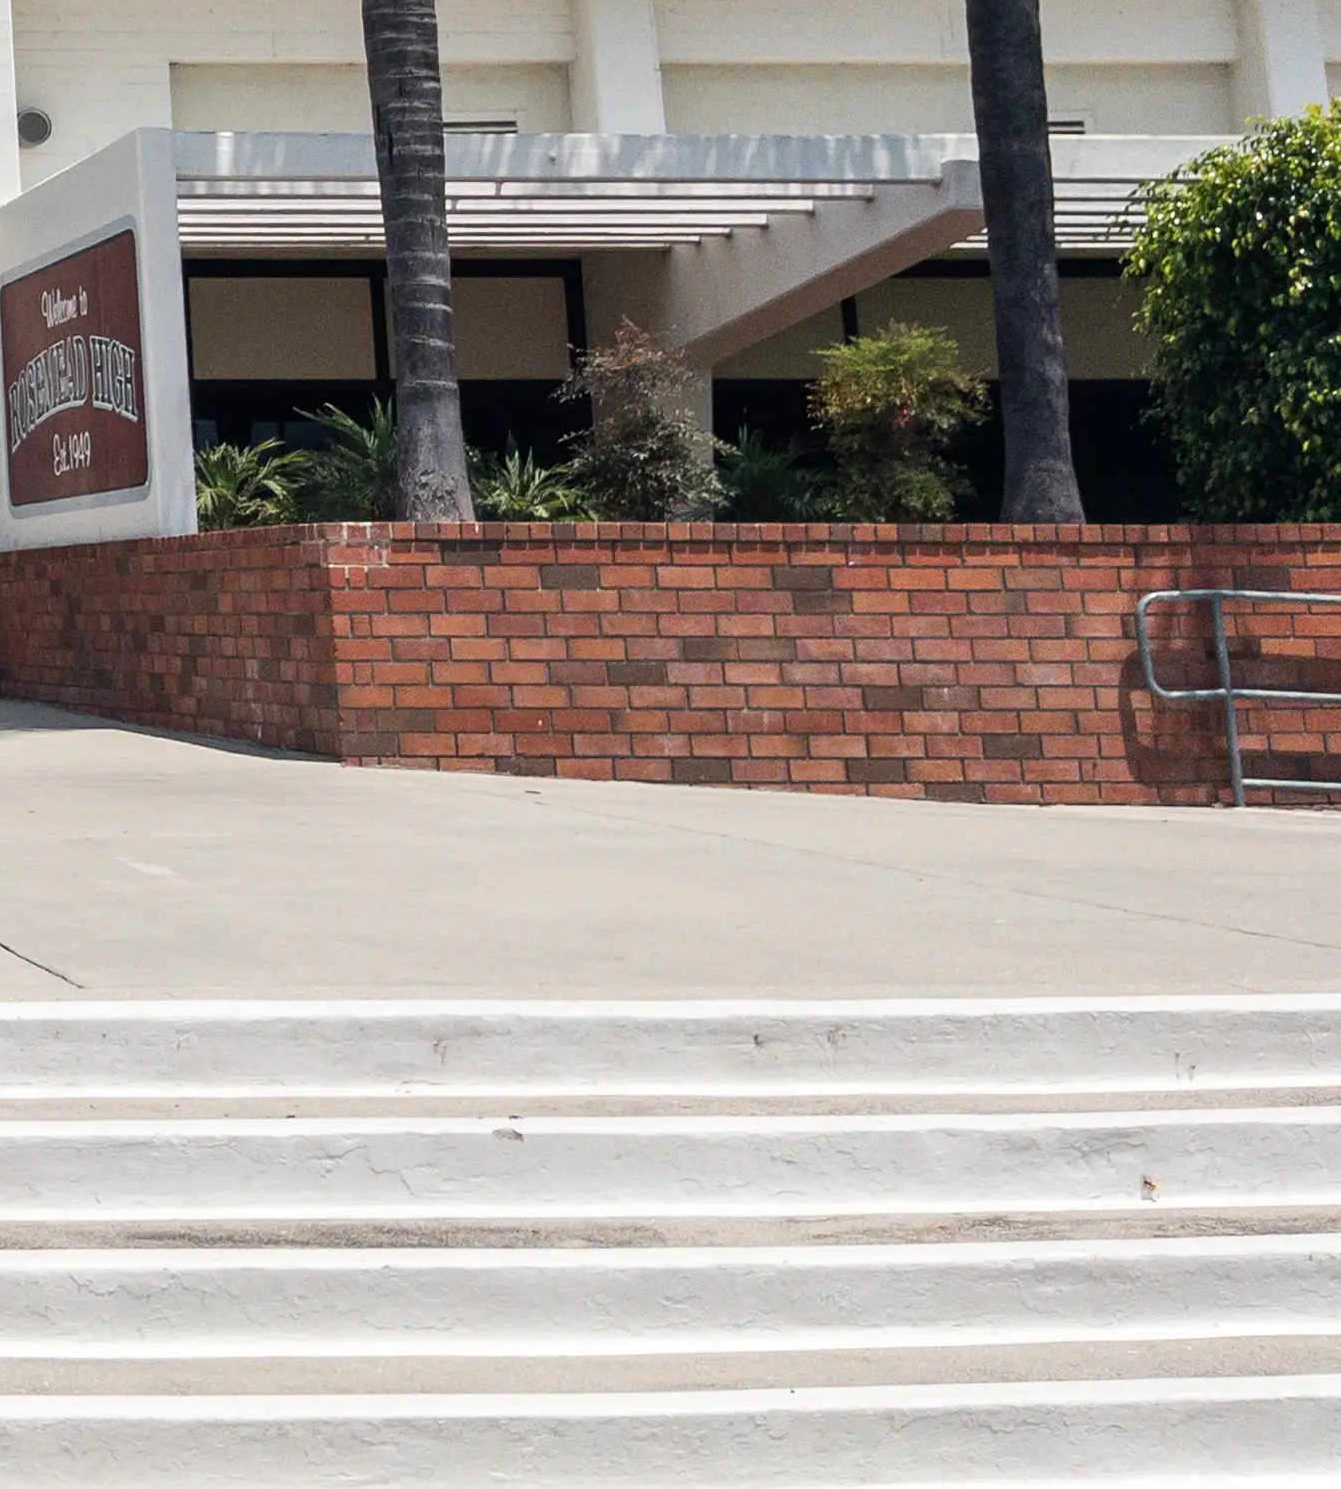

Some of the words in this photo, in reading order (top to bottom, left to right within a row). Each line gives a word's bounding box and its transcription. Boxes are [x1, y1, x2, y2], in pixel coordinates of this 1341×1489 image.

[41, 288, 77, 328] Welcome
[79, 285, 88, 316] to
[7, 335, 88, 454] ROSEMEAD
[89, 335, 138, 422] HIGH
